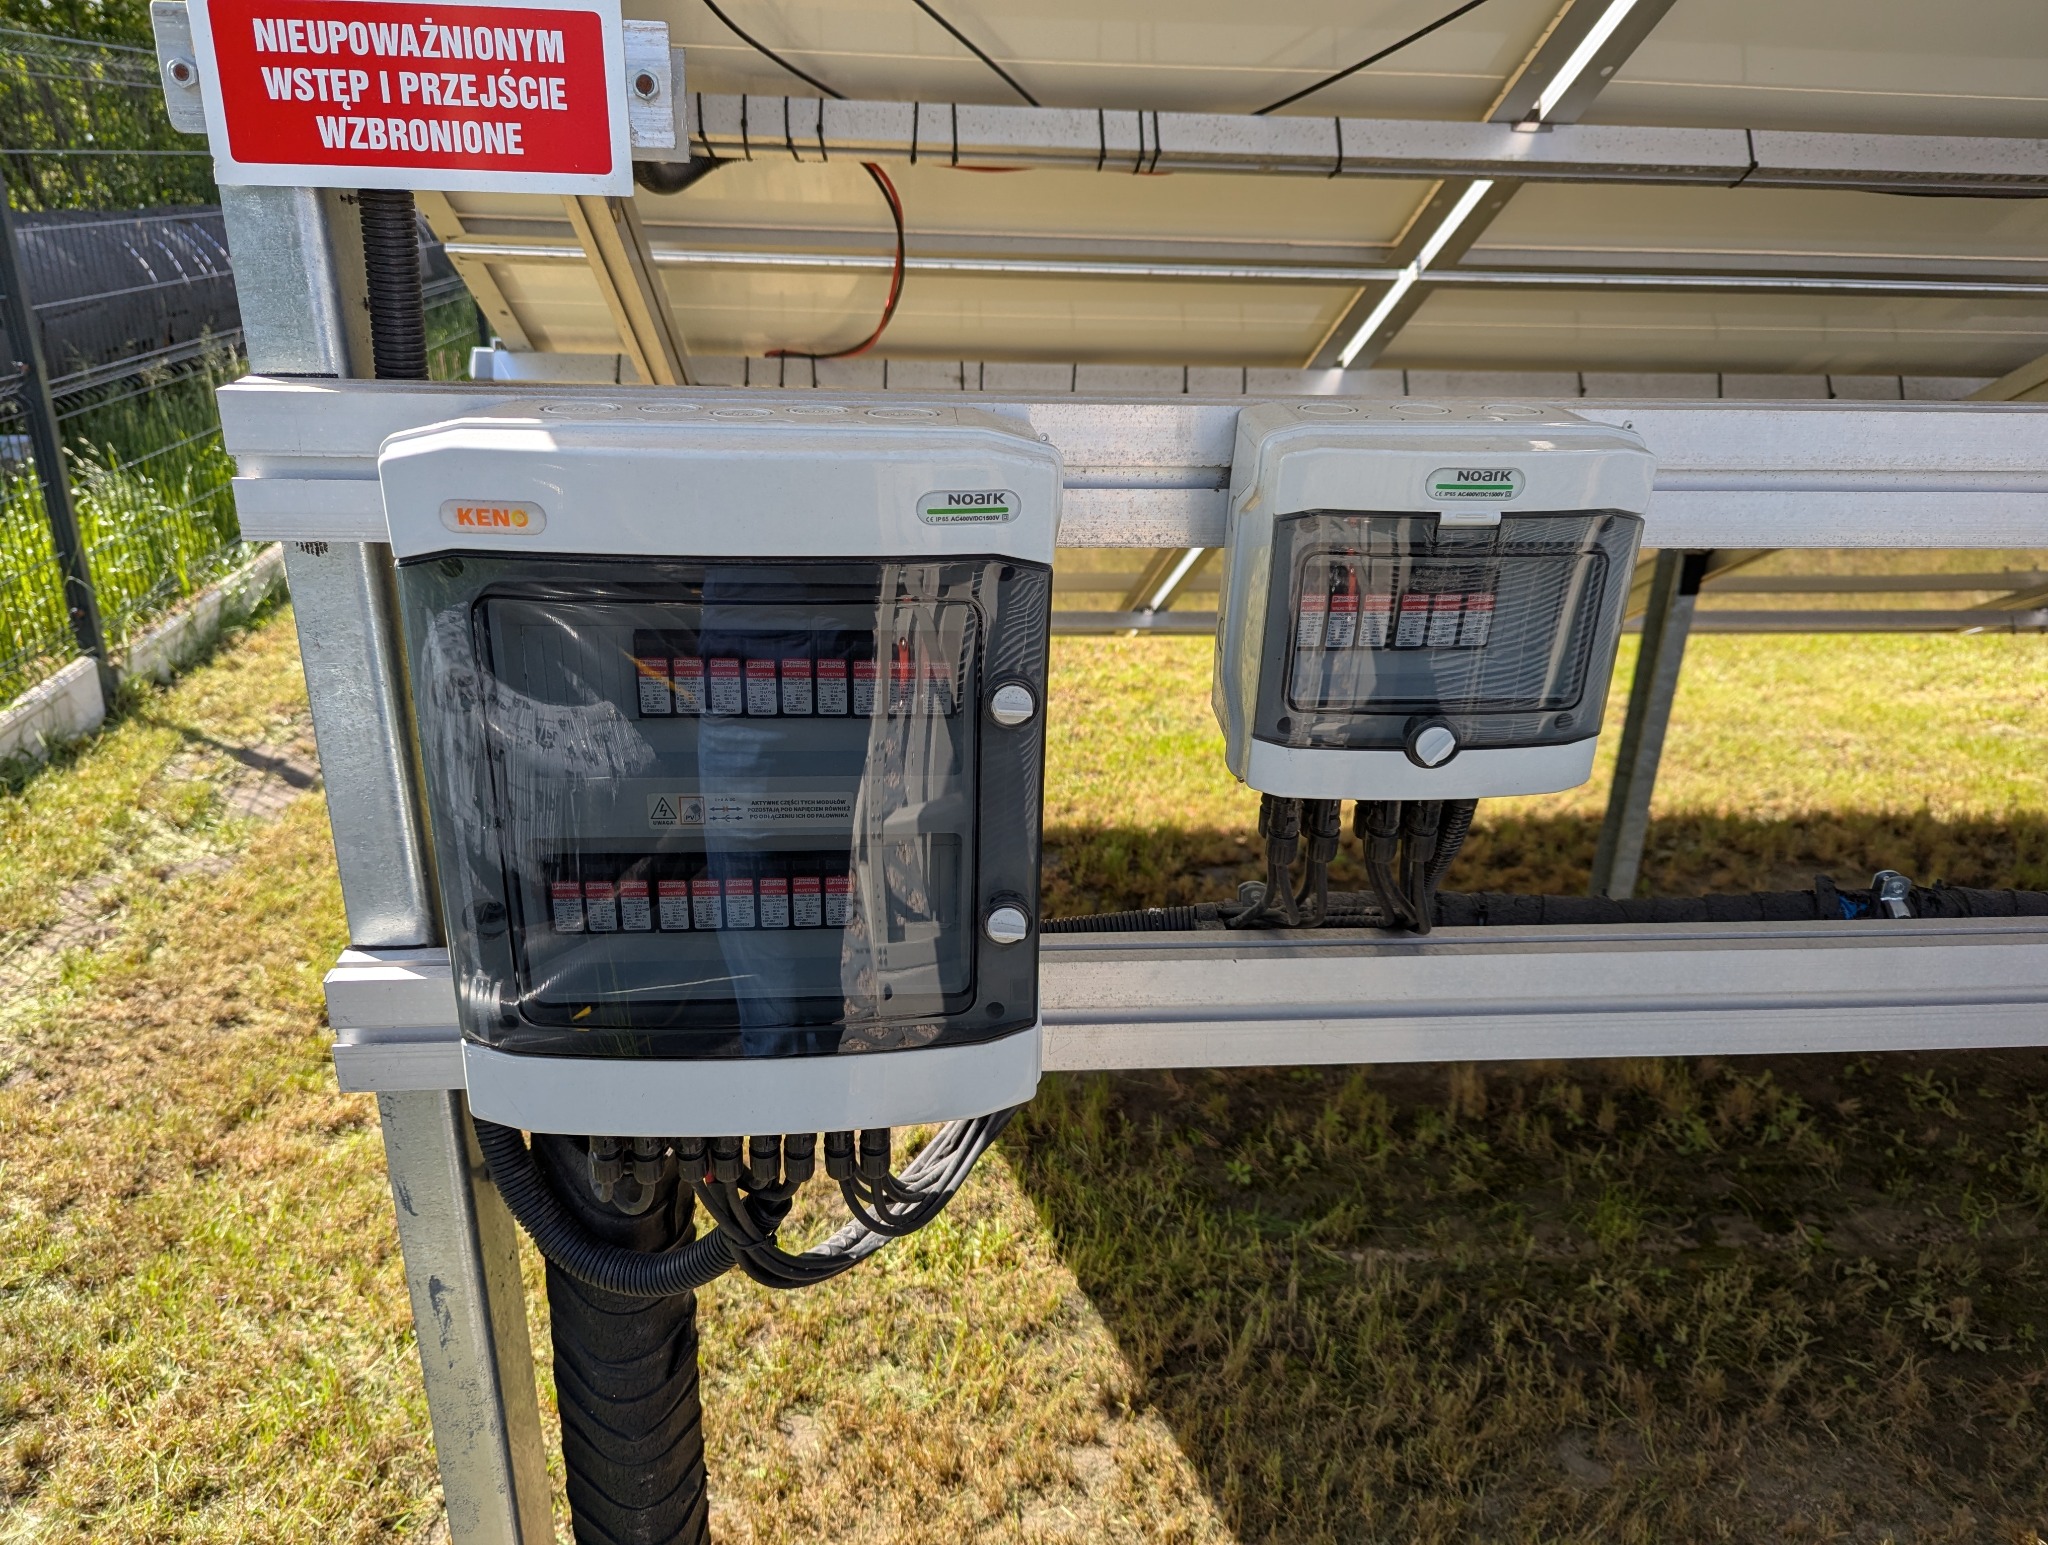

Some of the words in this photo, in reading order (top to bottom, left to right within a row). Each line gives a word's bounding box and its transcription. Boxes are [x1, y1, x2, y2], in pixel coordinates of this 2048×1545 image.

[252, 17, 566, 64] NIEUPOWAŻNIONYM
[260, 66, 369, 110] WSTĘP
[381, 71, 389, 102] I
[400, 69, 568, 111] PRZEJŚCIE
[315, 115, 525, 156] WZBRONIONE
[456, 507, 529, 528] KENO
